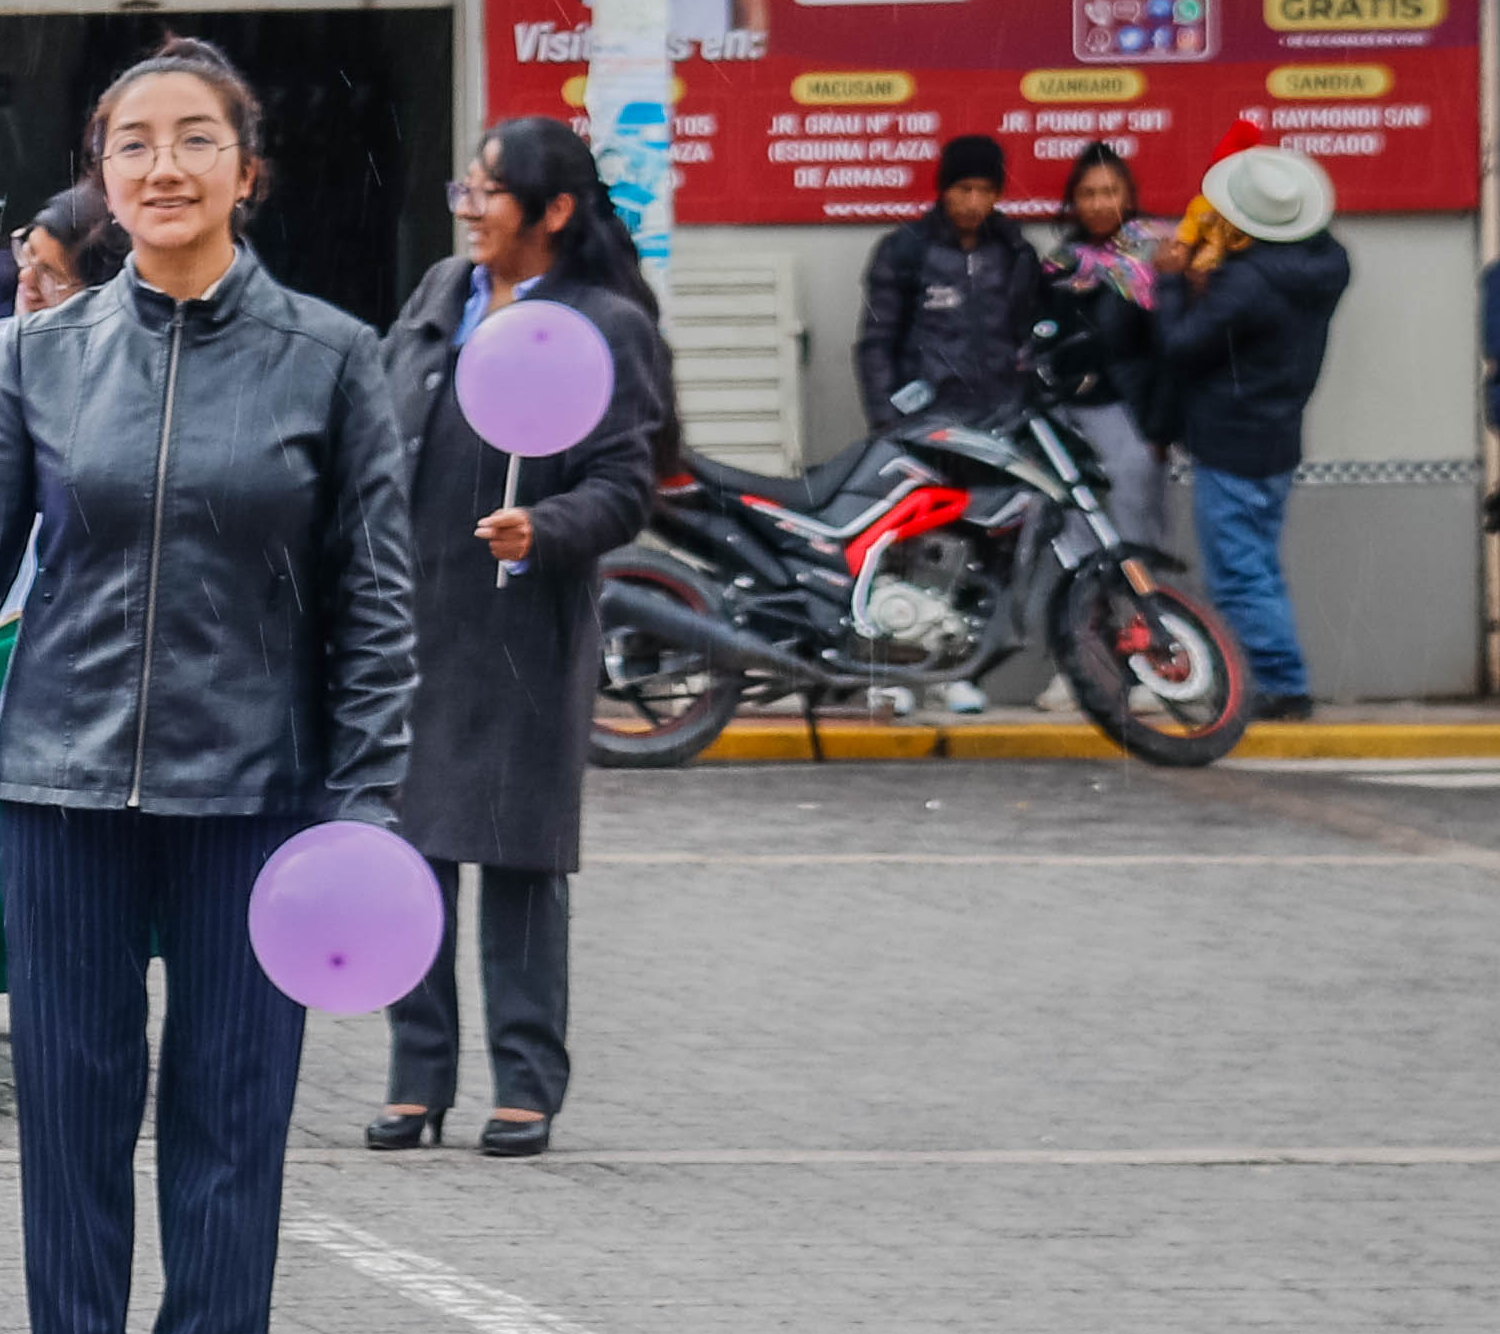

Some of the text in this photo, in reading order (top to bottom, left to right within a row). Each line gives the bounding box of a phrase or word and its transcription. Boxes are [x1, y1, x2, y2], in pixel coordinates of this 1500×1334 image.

[1036, 112, 1095, 132] PUNO
[1271, 106, 1426, 129] RAYMONDI S/N
[869, 139, 935, 161] PLAZA
[793, 169, 822, 189] DE
